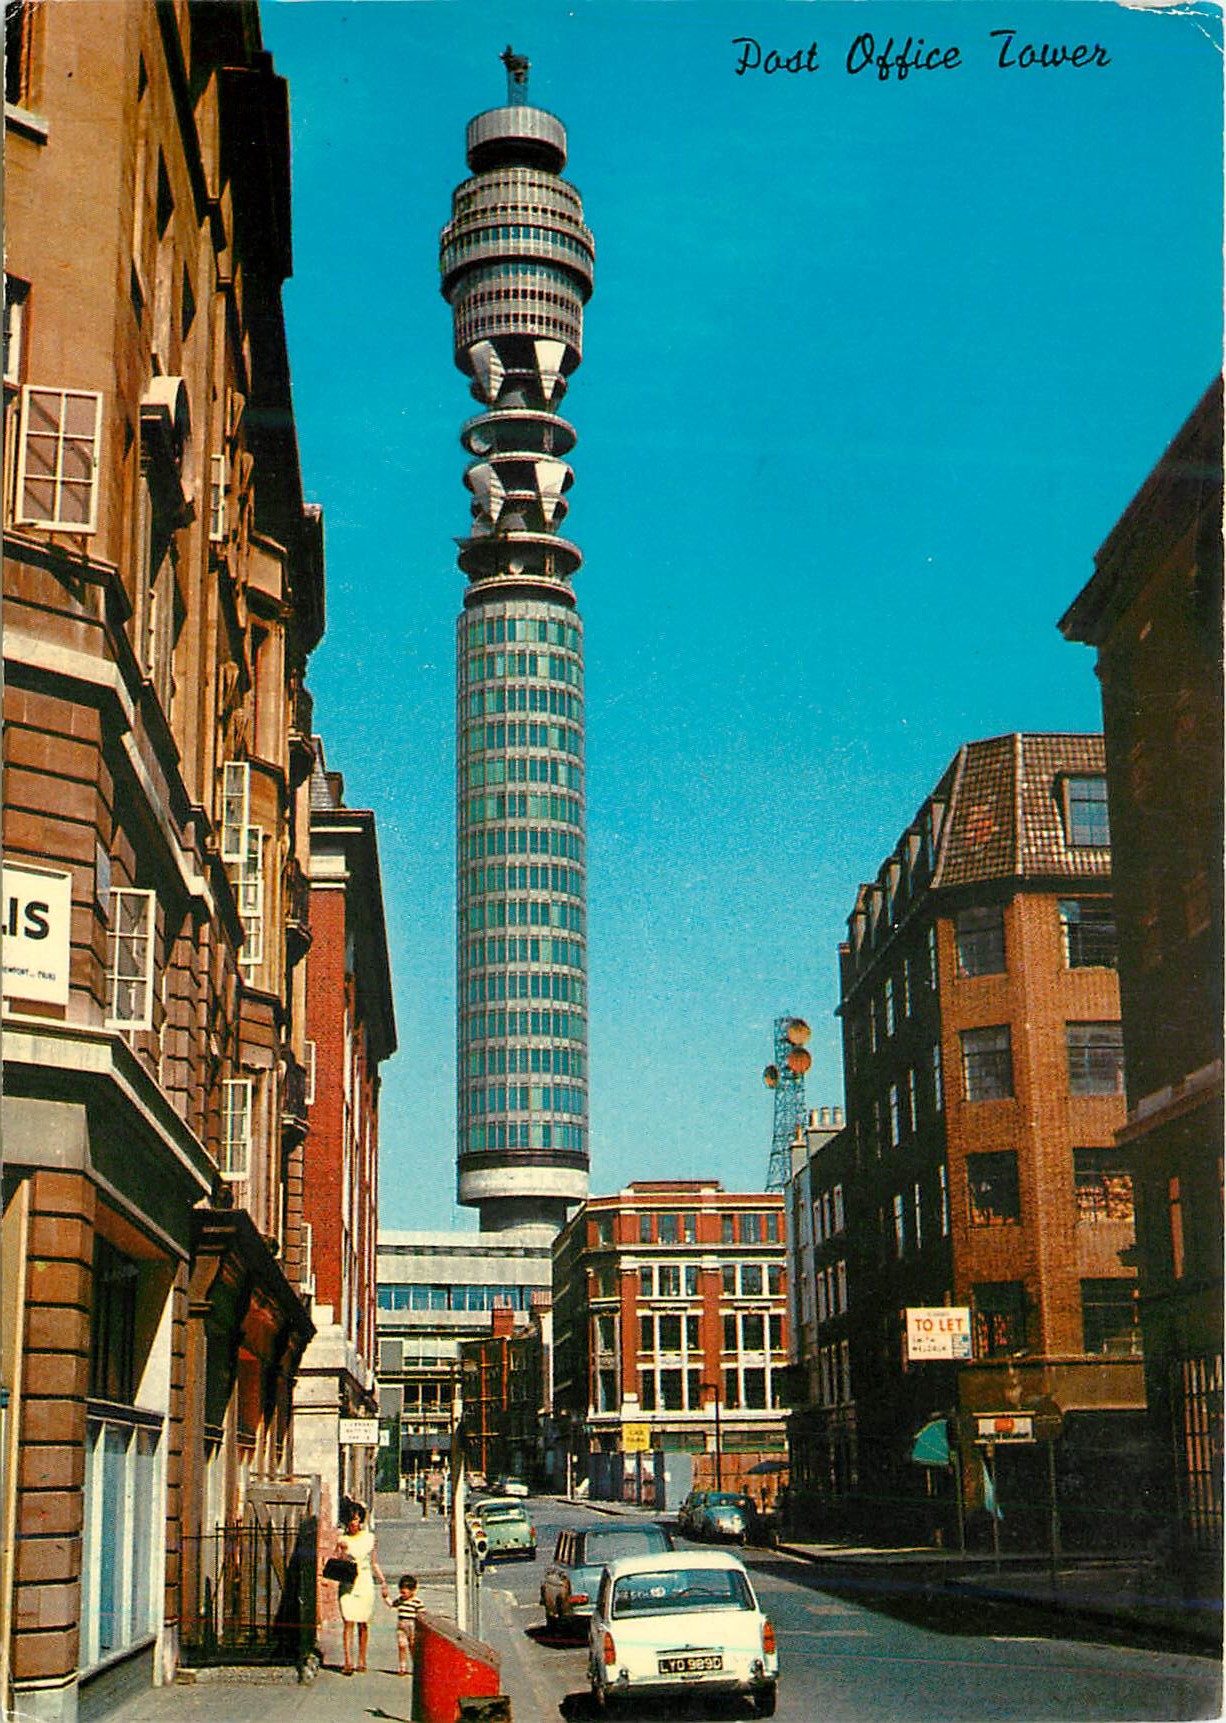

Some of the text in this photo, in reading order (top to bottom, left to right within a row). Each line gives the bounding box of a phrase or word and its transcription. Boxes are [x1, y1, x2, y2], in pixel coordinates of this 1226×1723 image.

[2, 896, 50, 940] IS
[915, 1318, 963, 1332] TO LET
